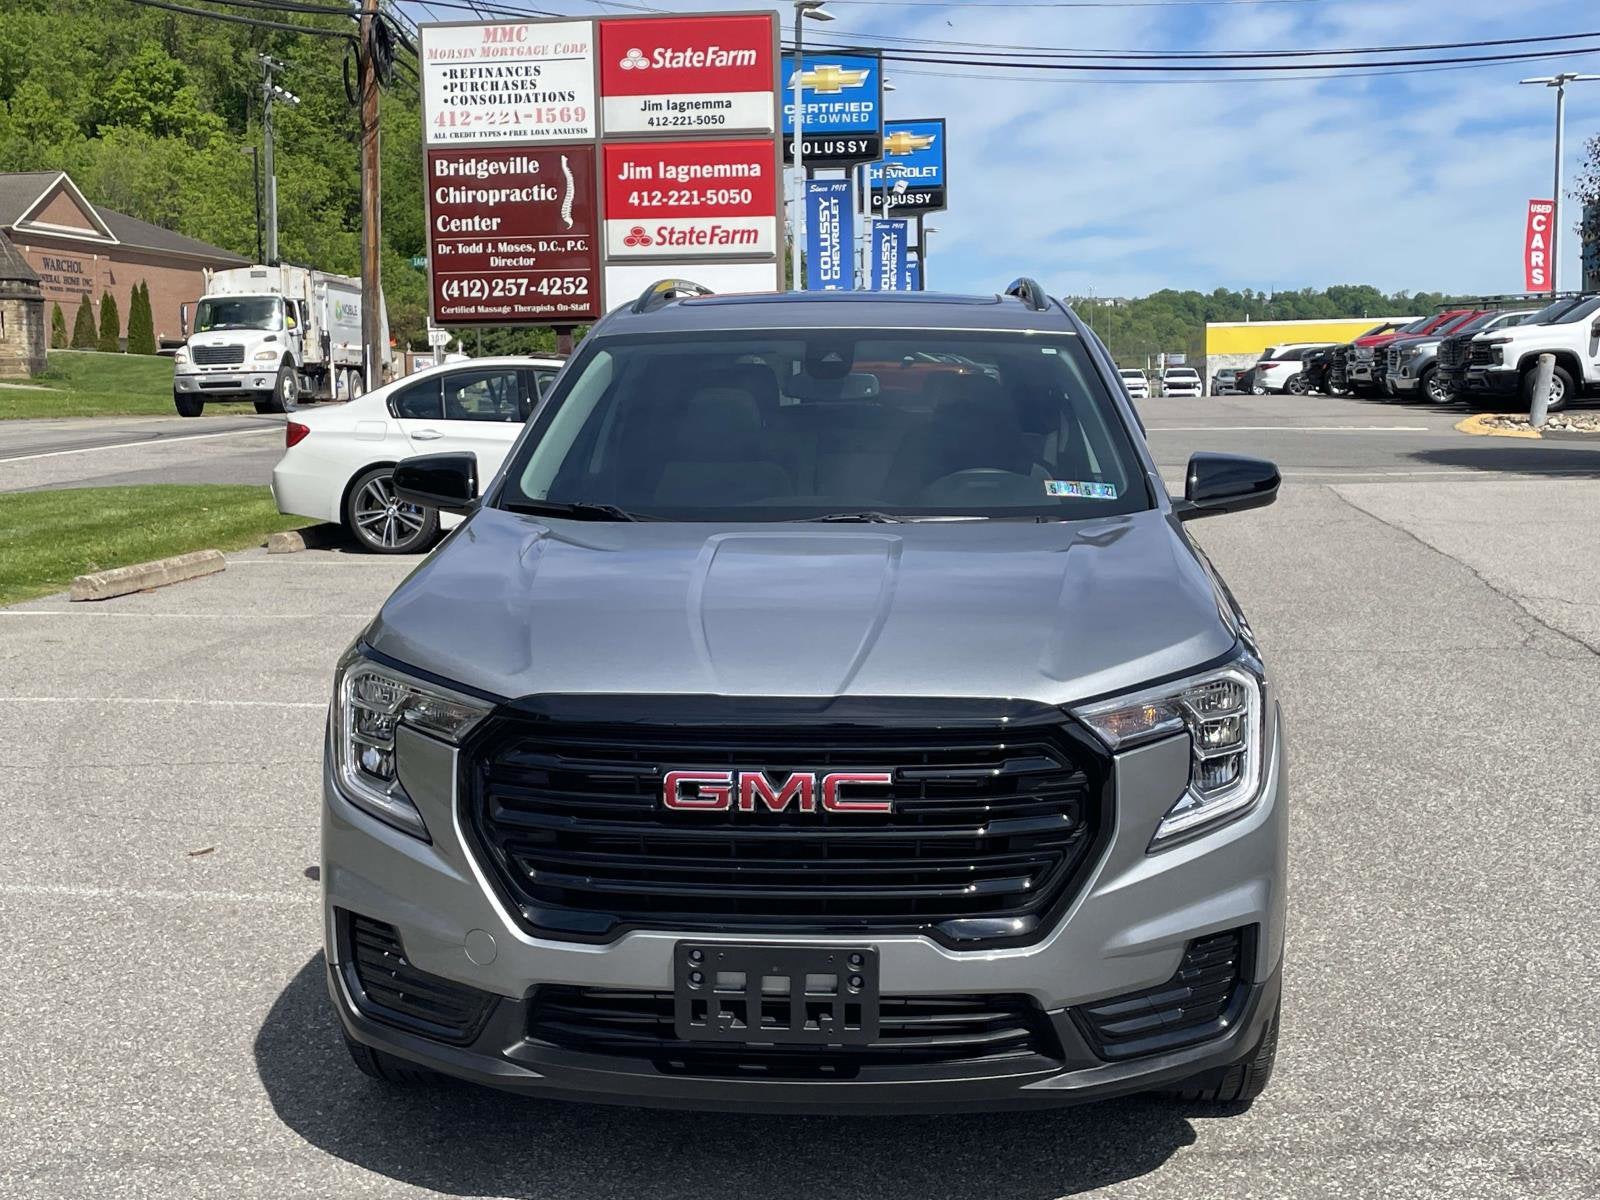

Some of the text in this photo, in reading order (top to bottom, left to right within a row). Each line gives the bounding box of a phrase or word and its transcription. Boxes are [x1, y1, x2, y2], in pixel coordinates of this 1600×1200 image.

[482, 25, 528, 43] MMC
[480, 44, 548, 58] MORTGAGE
[449, 65, 541, 79] REFINANCES
[450, 79, 537, 93] PURCHASES
[450, 91, 575, 106] CONSOLIDATIONS
[640, 99, 732, 113] Jim Iagnemma
[434, 106, 586, 127] 412-221-1569
[647, 115, 725, 127] 412-221-5050
[434, 132, 447, 140] ALL
[449, 131, 476, 139] CREDIT
[789, 141, 868, 155] COLUSSY
[435, 157, 539, 179] Bridgeville
[618, 161, 761, 183] Jim Iagnemma
[435, 184, 558, 206] Chiropractic
[628, 189, 752, 206] 412-221-5050
[1530, 204, 1552, 213] USED
[437, 215, 501, 232] Center
[819, 197, 831, 280] COLUSSY
[831, 196, 840, 280] CHEVROLET
[438, 243, 455, 255] Dr.
[457, 242, 483, 254] Todd
[486, 243, 495, 254] J.
[498, 242, 536, 253] Moses,
[567, 240, 588, 250] P.C.
[1530, 214, 1547, 285] CARS
[42, 257, 83, 273] WARCHOL
[490, 256, 536, 267] Director
[881, 232, 890, 291] OLUSSY
[890, 232, 898, 290] HEVROLET
[441, 303, 590, 315] Certified Massage Therapists On-Staff
[663, 770, 892, 814] GMC
